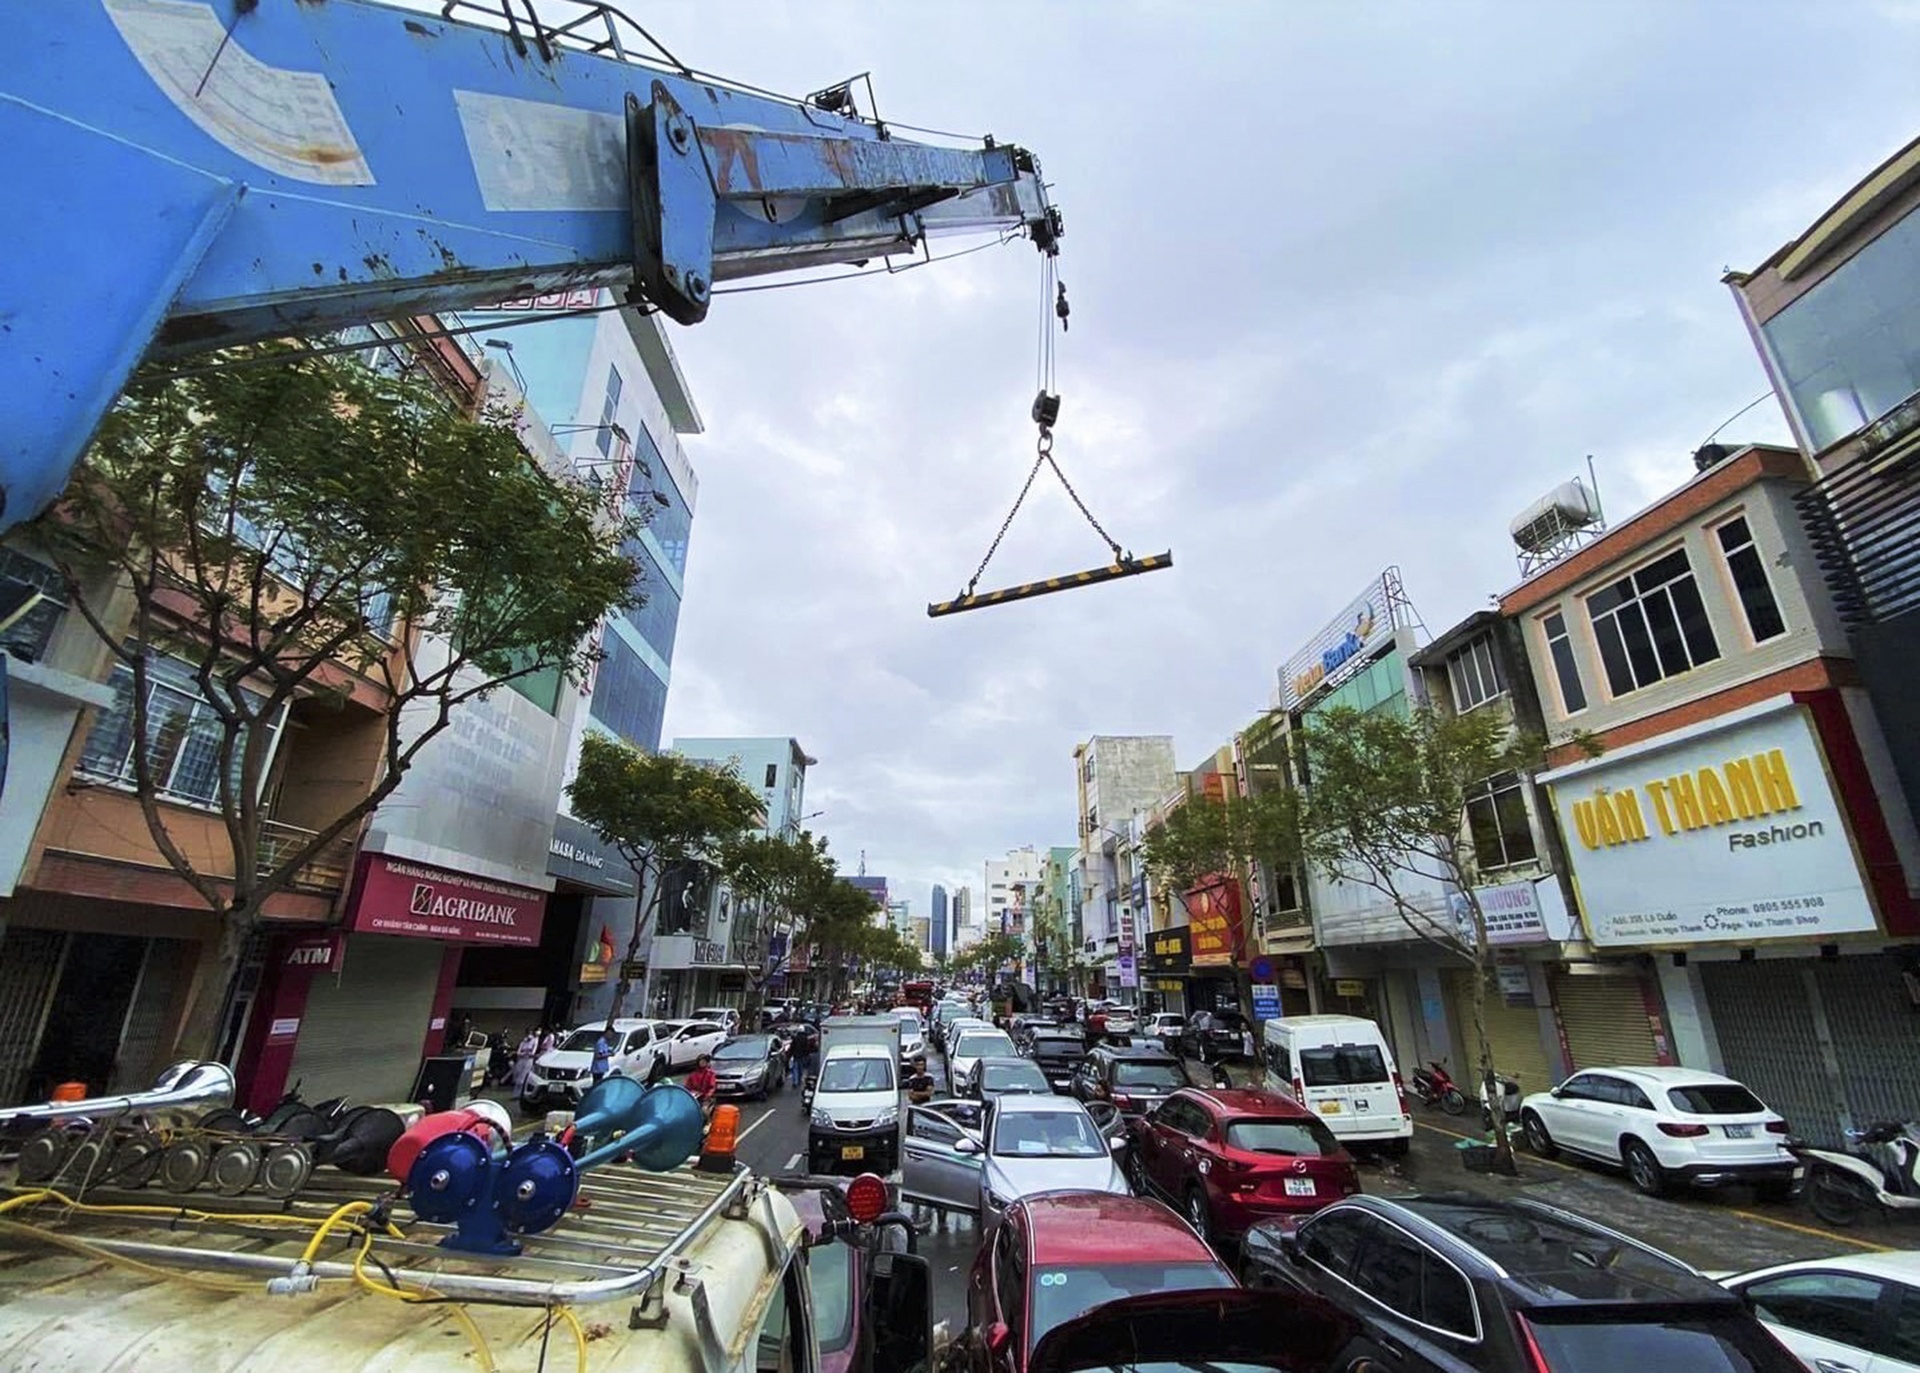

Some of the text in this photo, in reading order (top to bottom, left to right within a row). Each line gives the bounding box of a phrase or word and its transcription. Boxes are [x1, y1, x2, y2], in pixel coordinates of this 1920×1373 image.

[1645, 749, 1801, 836] THANH
[1729, 821, 1824, 851] Fashion
[432, 895, 517, 926] AGRIBANK
[288, 947, 331, 964] ATM
